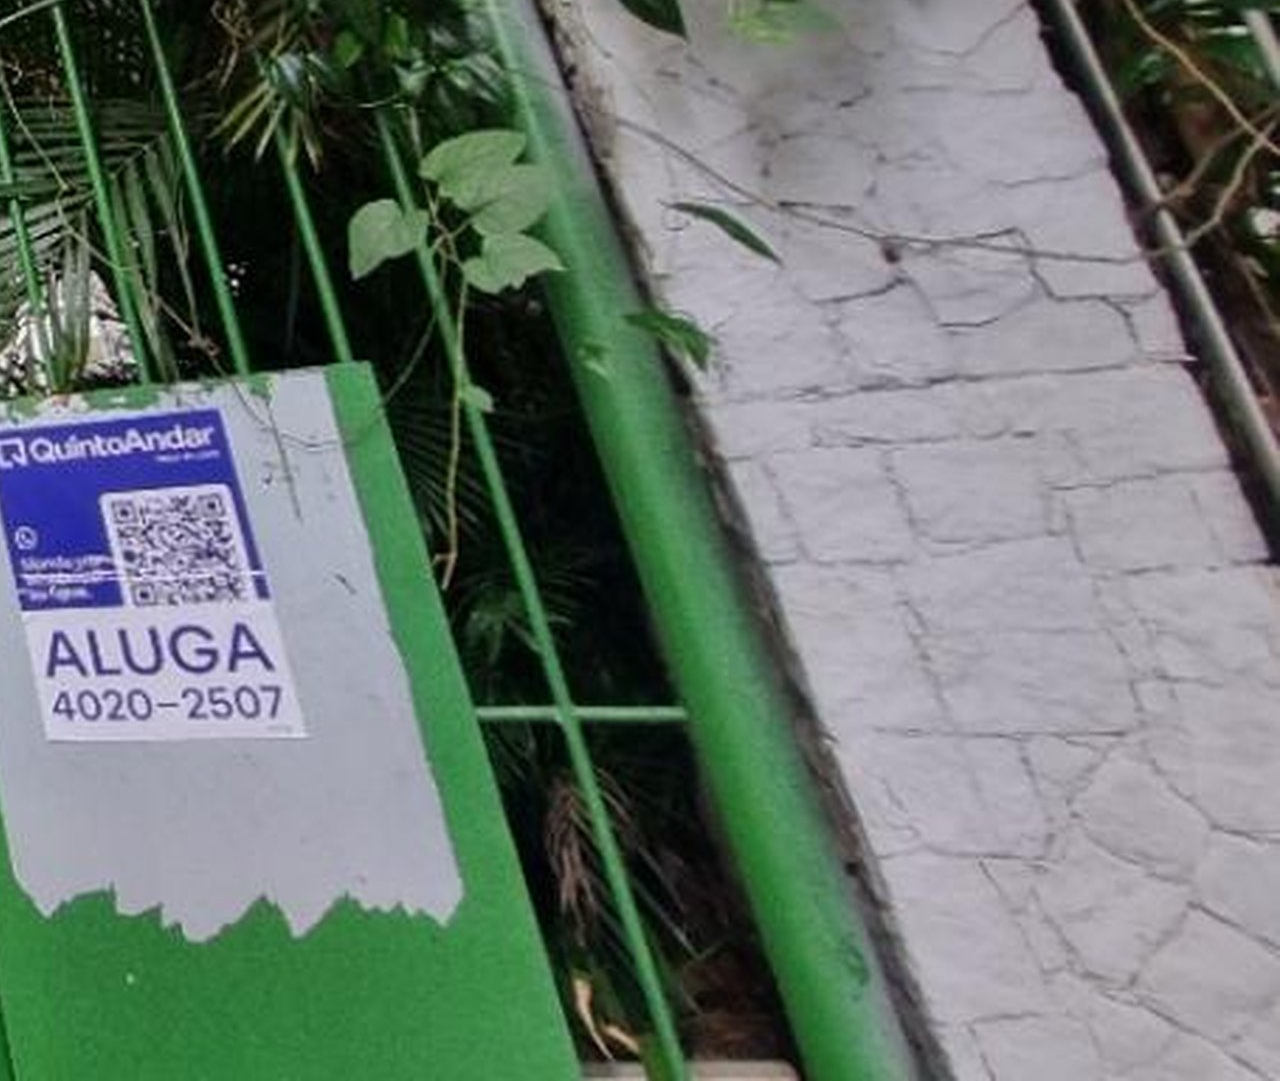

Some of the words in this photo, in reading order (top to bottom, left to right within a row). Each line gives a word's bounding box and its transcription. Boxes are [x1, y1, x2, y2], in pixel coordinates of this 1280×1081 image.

[29, 424, 215, 463] QuintoAndar
[46, 622, 275, 677] ALUGA
[52, 685, 282, 721] 4020-2507
